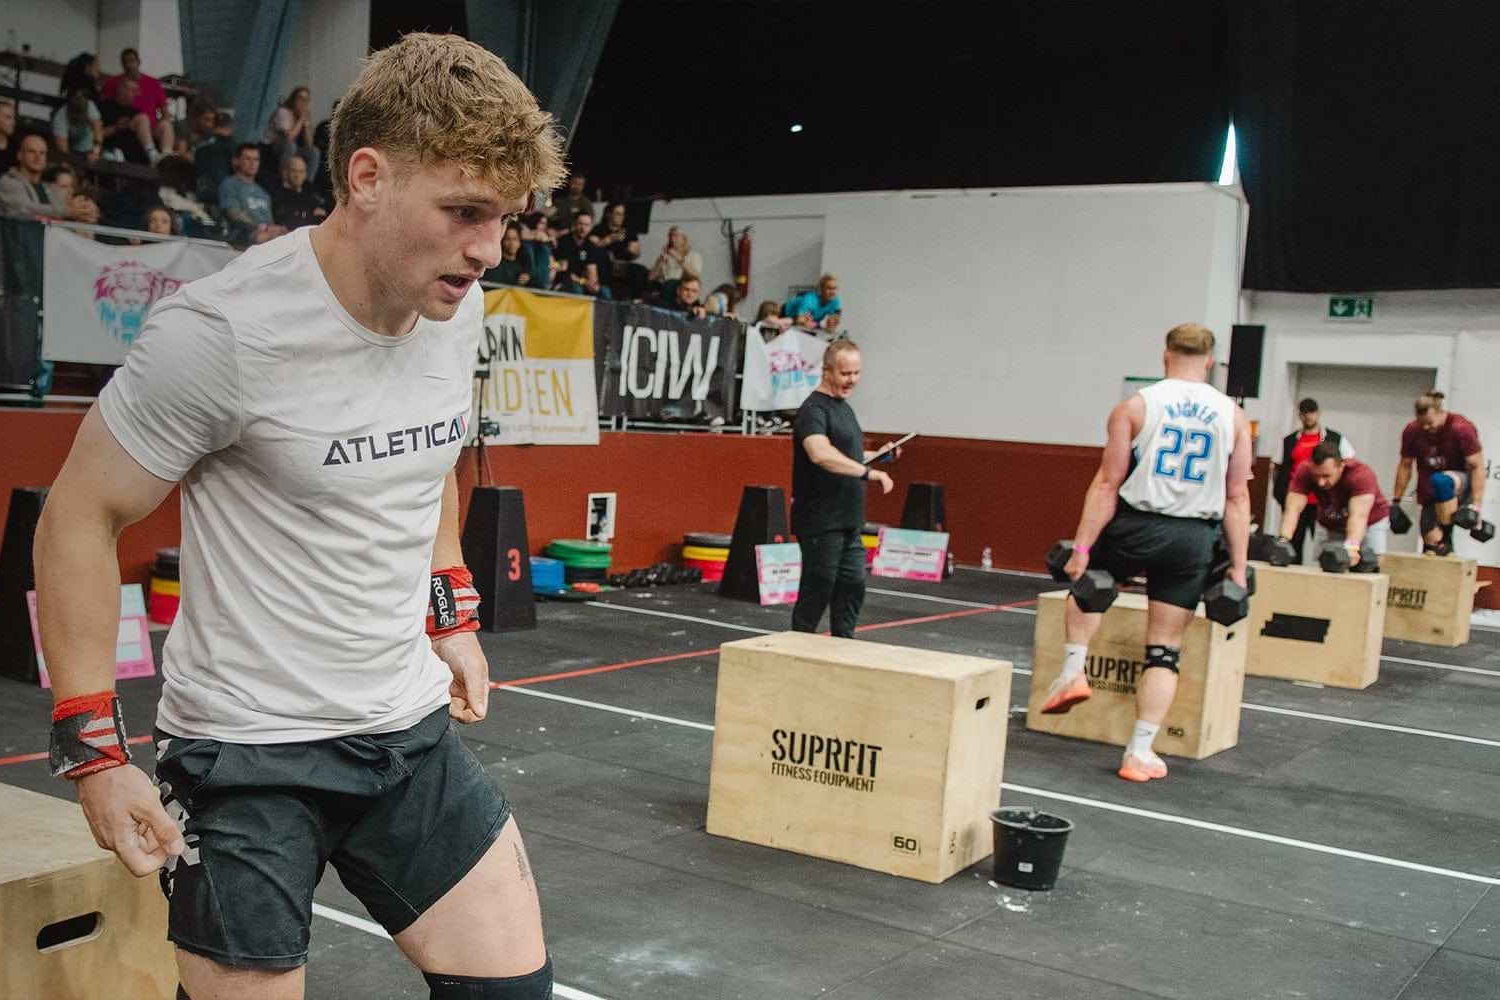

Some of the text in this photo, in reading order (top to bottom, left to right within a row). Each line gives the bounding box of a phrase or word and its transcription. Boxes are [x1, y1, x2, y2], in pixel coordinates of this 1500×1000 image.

[618, 325, 721, 401] ICIW
[322, 417, 462, 466] ATLETICA
[1153, 424, 1213, 485] 22
[507, 547, 521, 582] 3
[431, 576, 450, 627] ROGUE
[771, 728, 883, 778] SUPRFIT
[771, 762, 876, 792] FITNESS EQUIPMENT
[894, 836, 917, 851] 60
